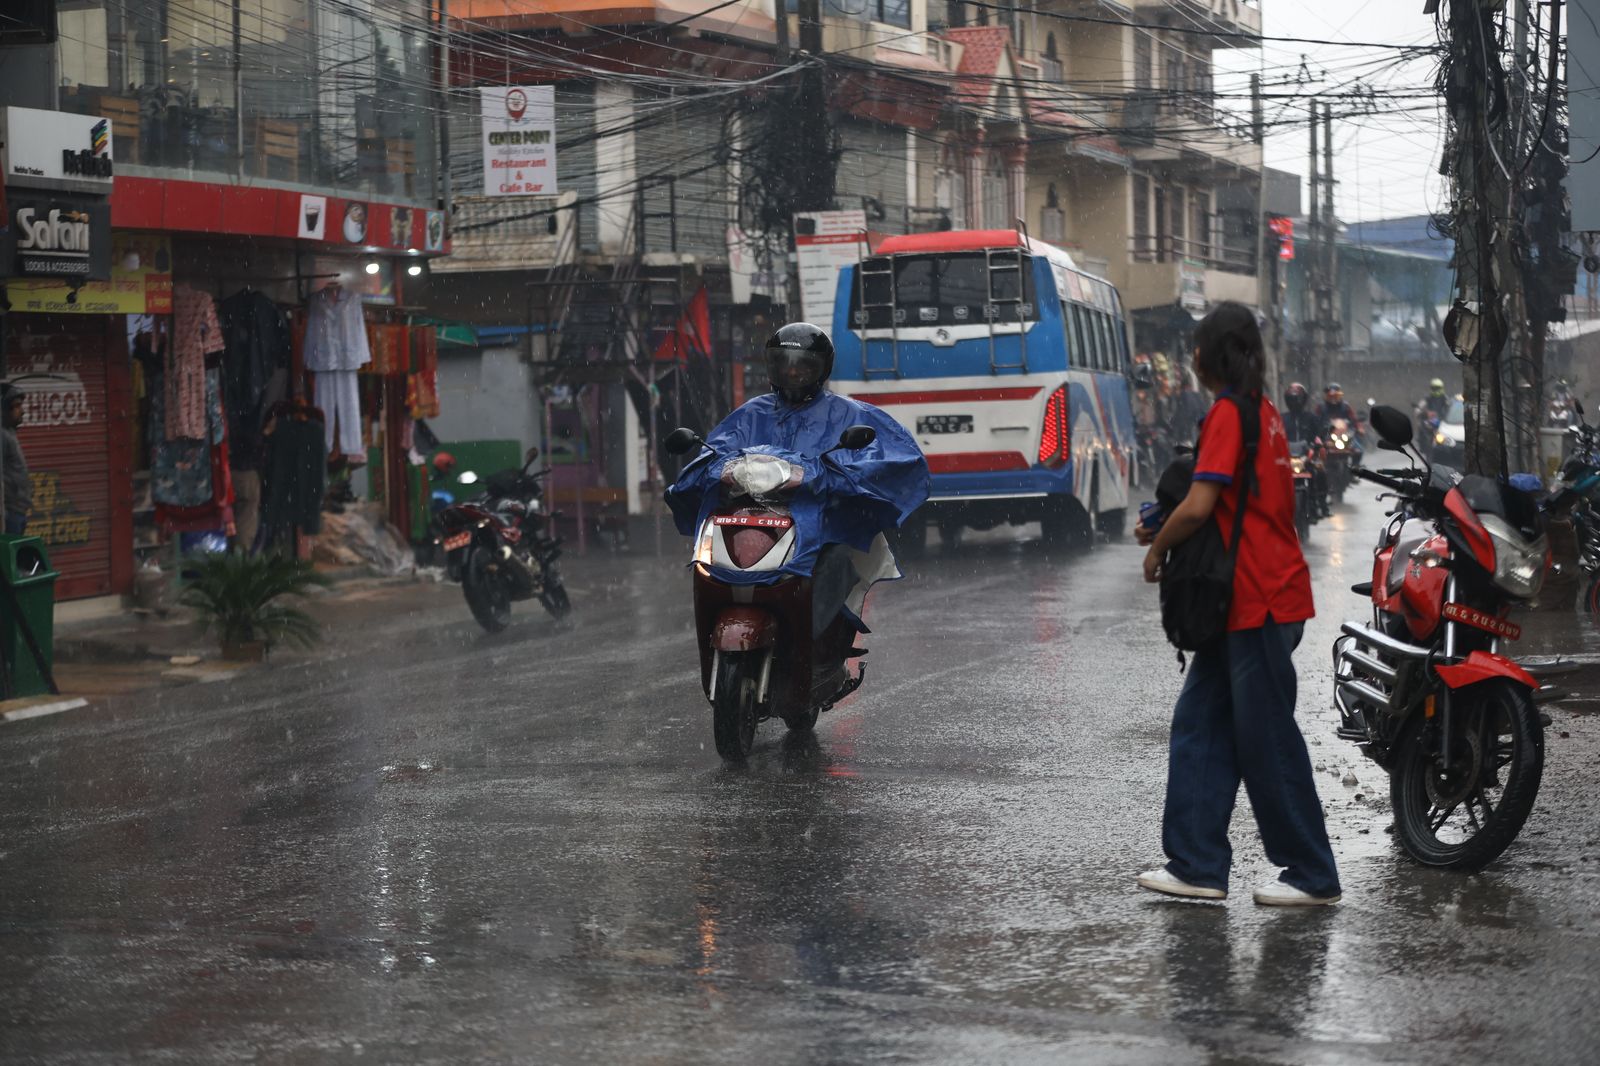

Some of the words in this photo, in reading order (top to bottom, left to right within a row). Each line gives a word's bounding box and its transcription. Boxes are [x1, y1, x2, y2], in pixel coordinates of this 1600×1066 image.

[489, 131, 522, 146] CENTER
[491, 158, 547, 168] Restaurant
[514, 170, 524, 180] &
[499, 182, 522, 193] Cafe
[525, 182, 545, 193] Bar
[16, 207, 90, 251] Safari
